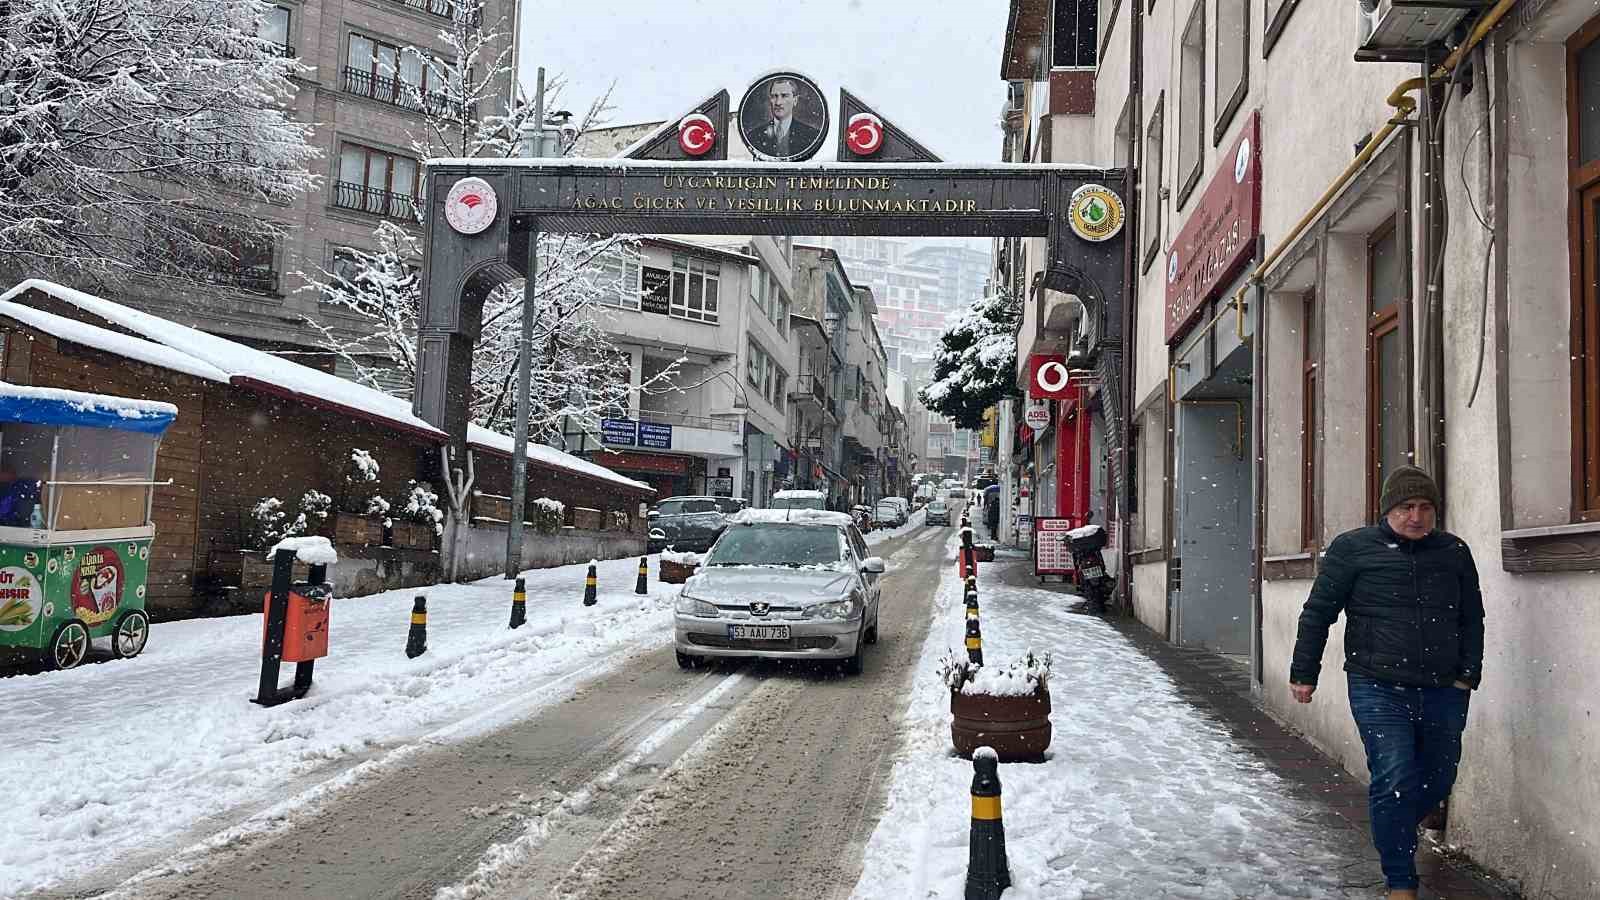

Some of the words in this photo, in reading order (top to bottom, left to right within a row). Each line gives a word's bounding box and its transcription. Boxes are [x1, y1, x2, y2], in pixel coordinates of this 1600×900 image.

[696, 197, 716, 209] VE
[814, 199, 977, 211] BULUNMAKTADIR
[1028, 410, 1048, 418] ADSL
[736, 626, 746, 638] 53
[750, 627, 767, 639] AAU
[770, 628, 788, 639] 736
